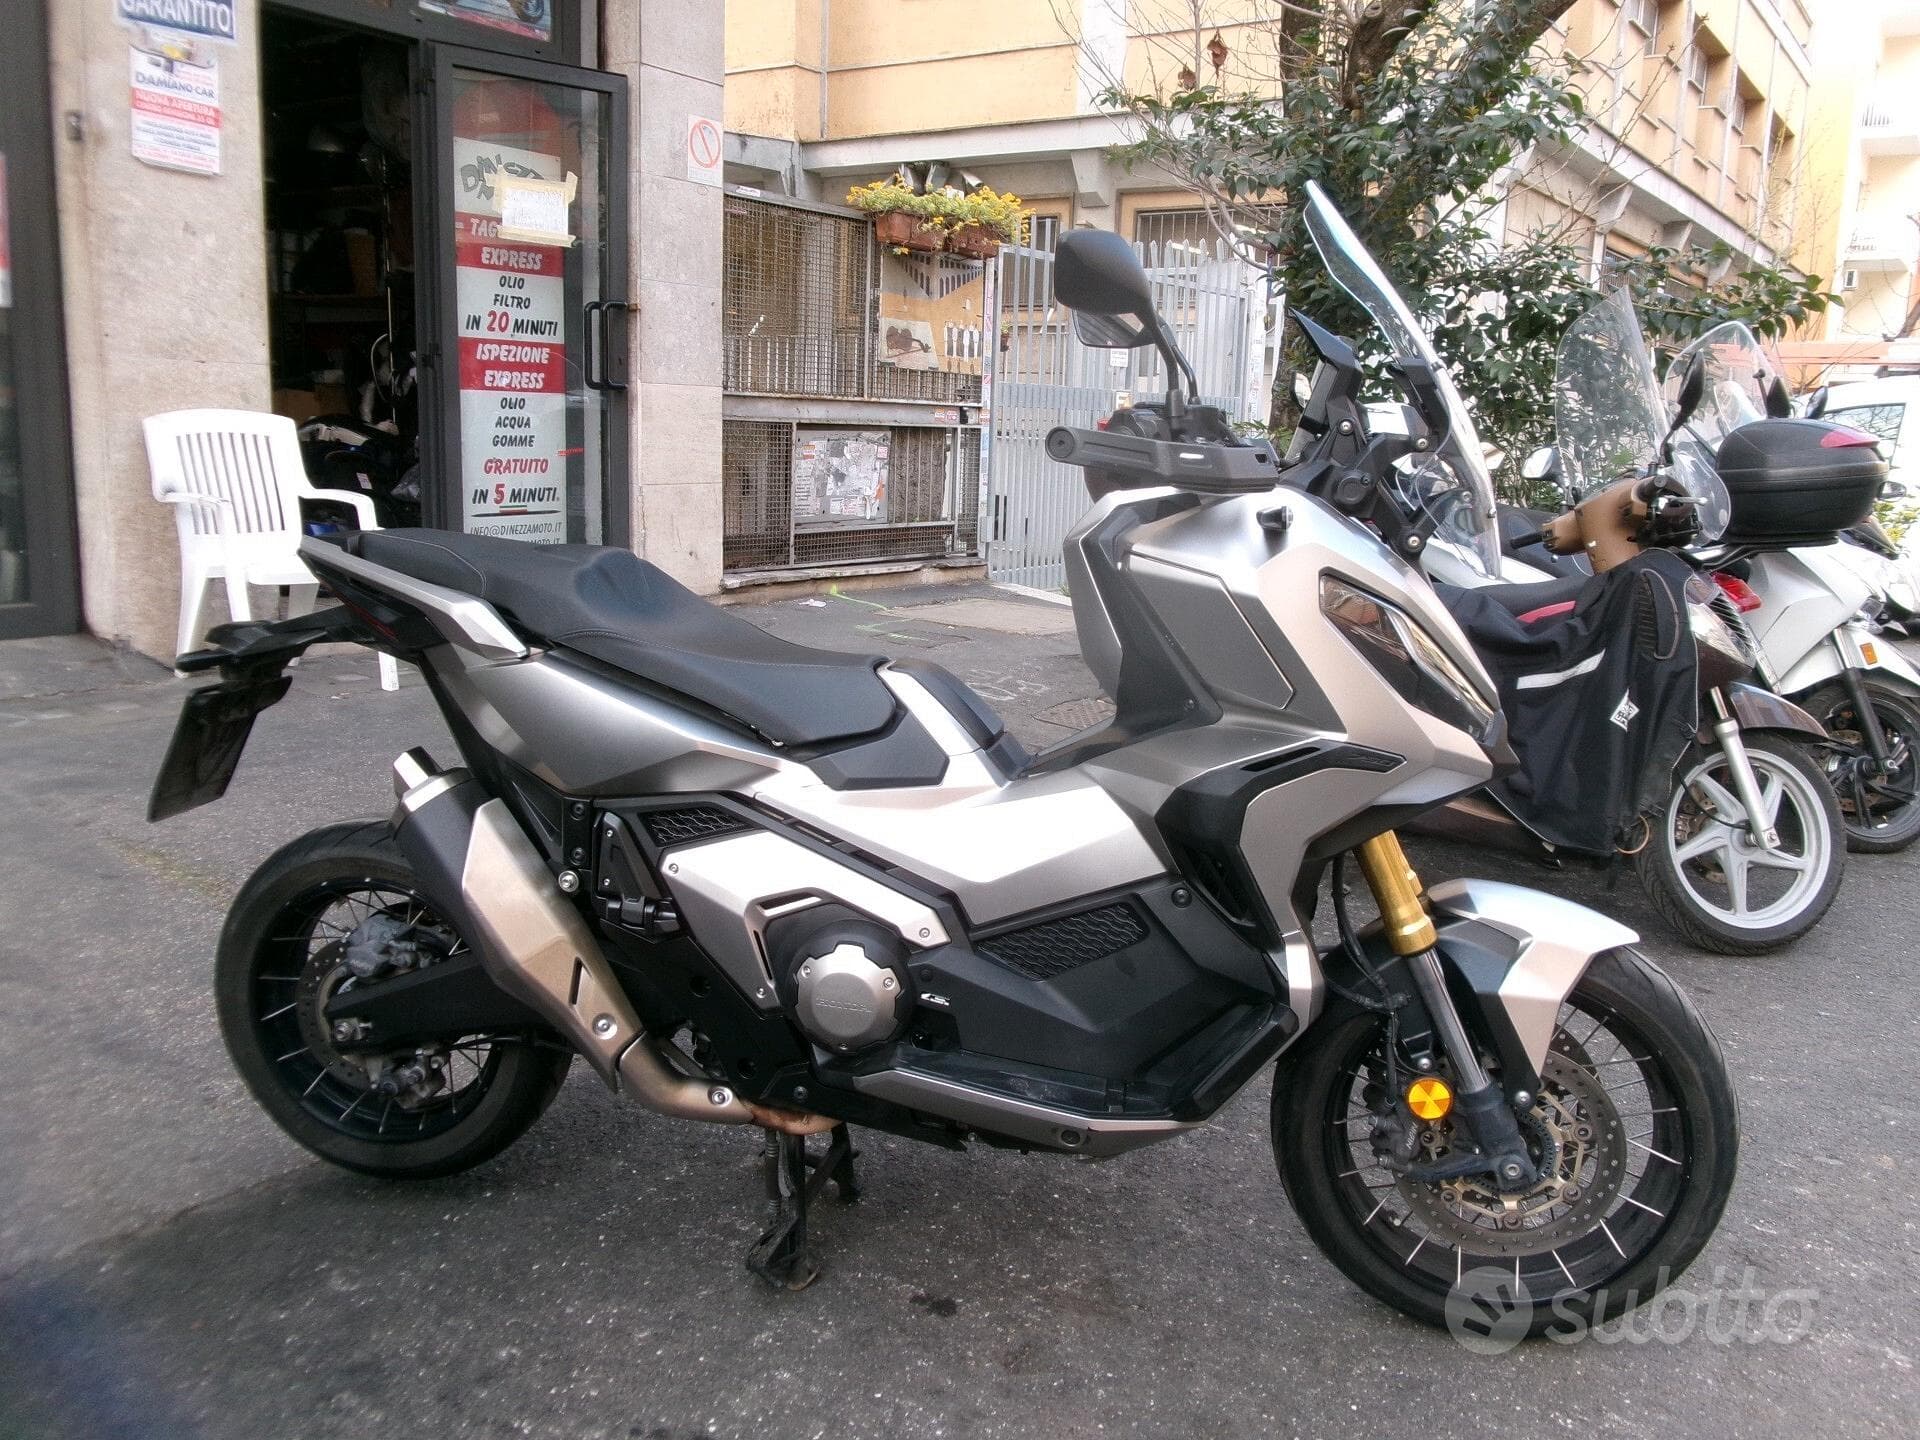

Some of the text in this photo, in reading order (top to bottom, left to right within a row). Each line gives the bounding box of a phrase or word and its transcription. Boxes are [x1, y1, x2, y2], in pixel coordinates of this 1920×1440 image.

[481, 246, 543, 270] EXPRESS
[499, 275, 525, 290] OLIO
[493, 293, 531, 309] FILTRO
[465, 310, 558, 336] IN 20 MINUTI
[476, 343, 551, 364] ISPEZIONE
[484, 370, 545, 389] EXPRESS
[500, 397, 526, 410] OLIO
[495, 416, 531, 429] ACQUA
[492, 435, 535, 447] GOMME
[484, 458, 549, 474] GRATUITO
[471, 489, 489, 504] IN
[493, 483, 505, 504] 5
